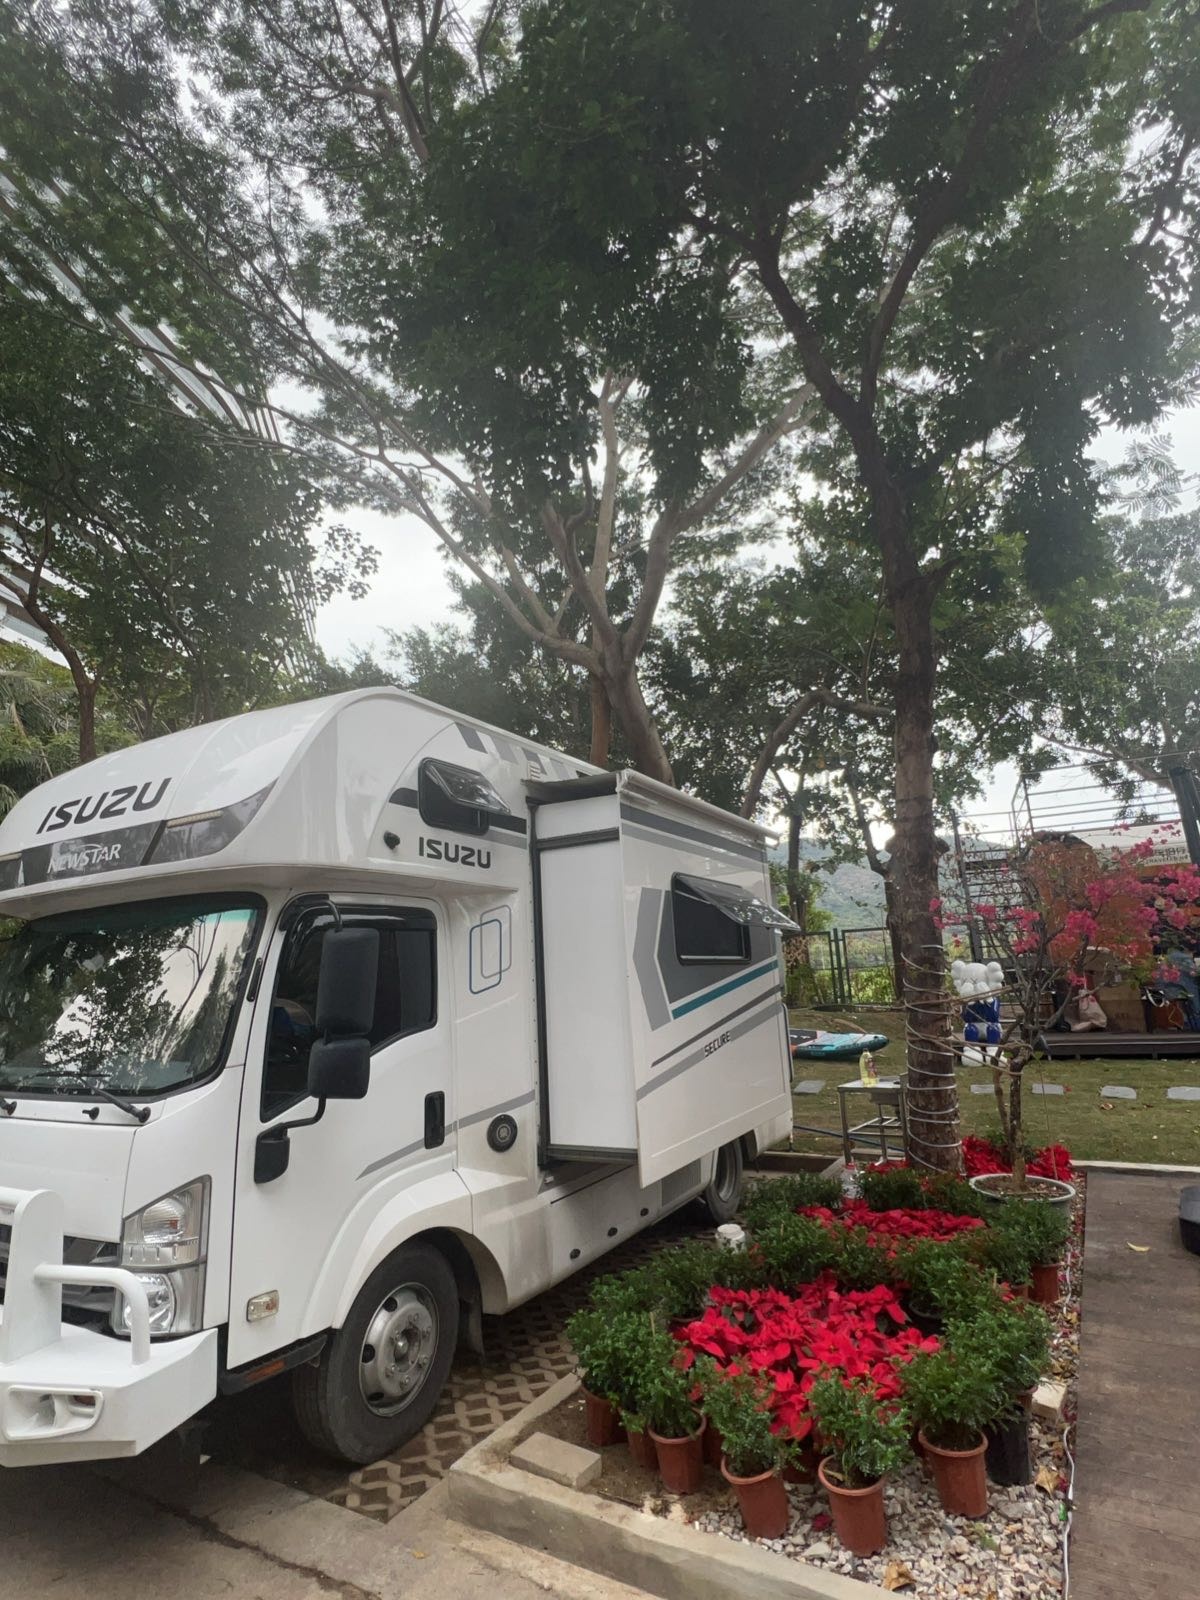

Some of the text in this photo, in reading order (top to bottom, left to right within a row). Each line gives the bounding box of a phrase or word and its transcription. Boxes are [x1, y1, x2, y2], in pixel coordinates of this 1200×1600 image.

[36, 777, 172, 834] ISUZU
[47, 844, 121, 874] NEWSTAR
[418, 836, 491, 869] ISUZU
[704, 1030, 731, 1058] SECURE
